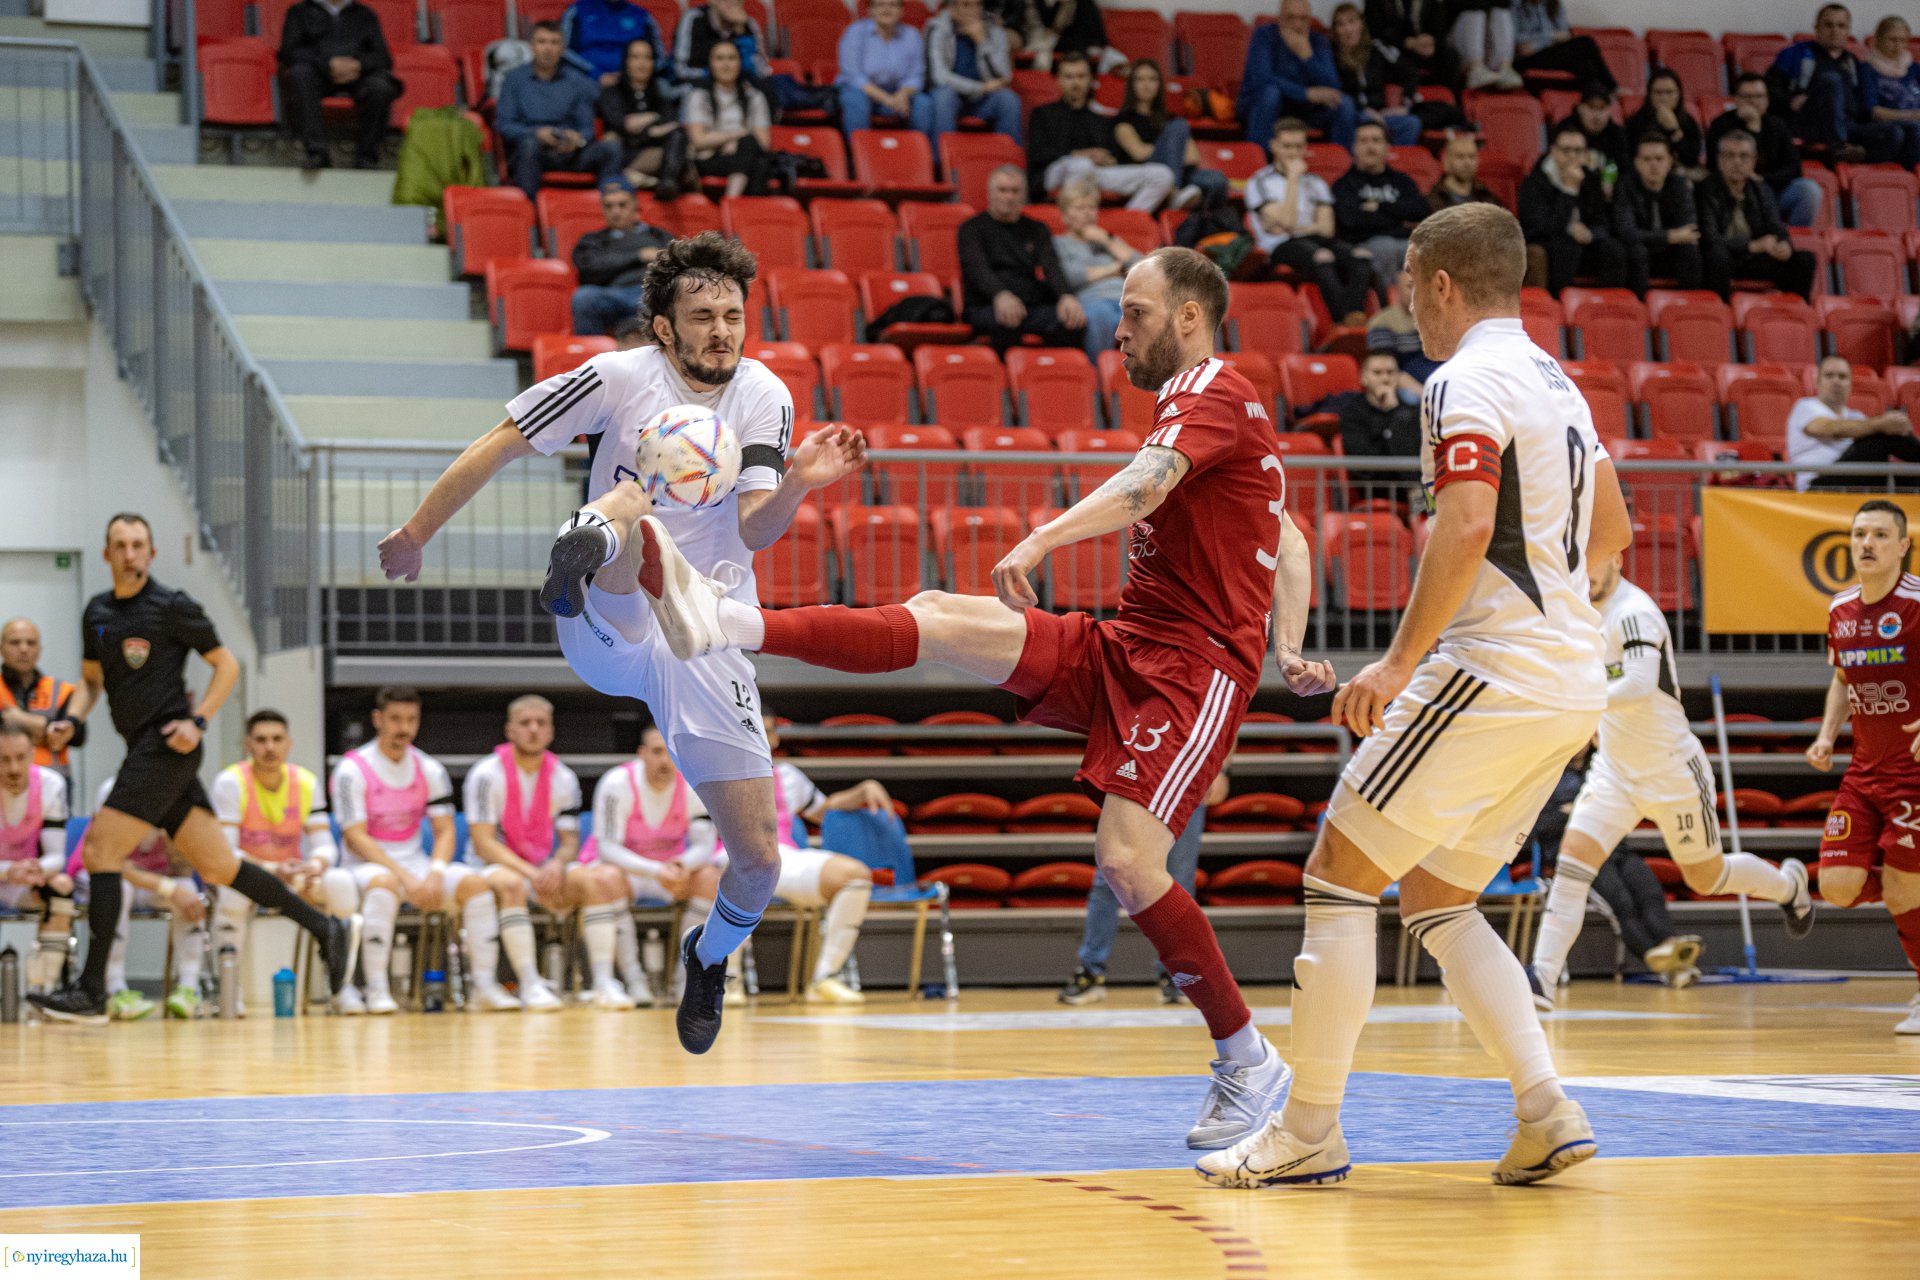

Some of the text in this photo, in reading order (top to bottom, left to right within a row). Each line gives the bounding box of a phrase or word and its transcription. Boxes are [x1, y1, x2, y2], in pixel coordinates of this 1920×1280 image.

[1448, 441, 1478, 472] C
[1835, 619, 1857, 638] 383
[731, 680, 754, 712] 12
[1677, 813, 1694, 831] 10
